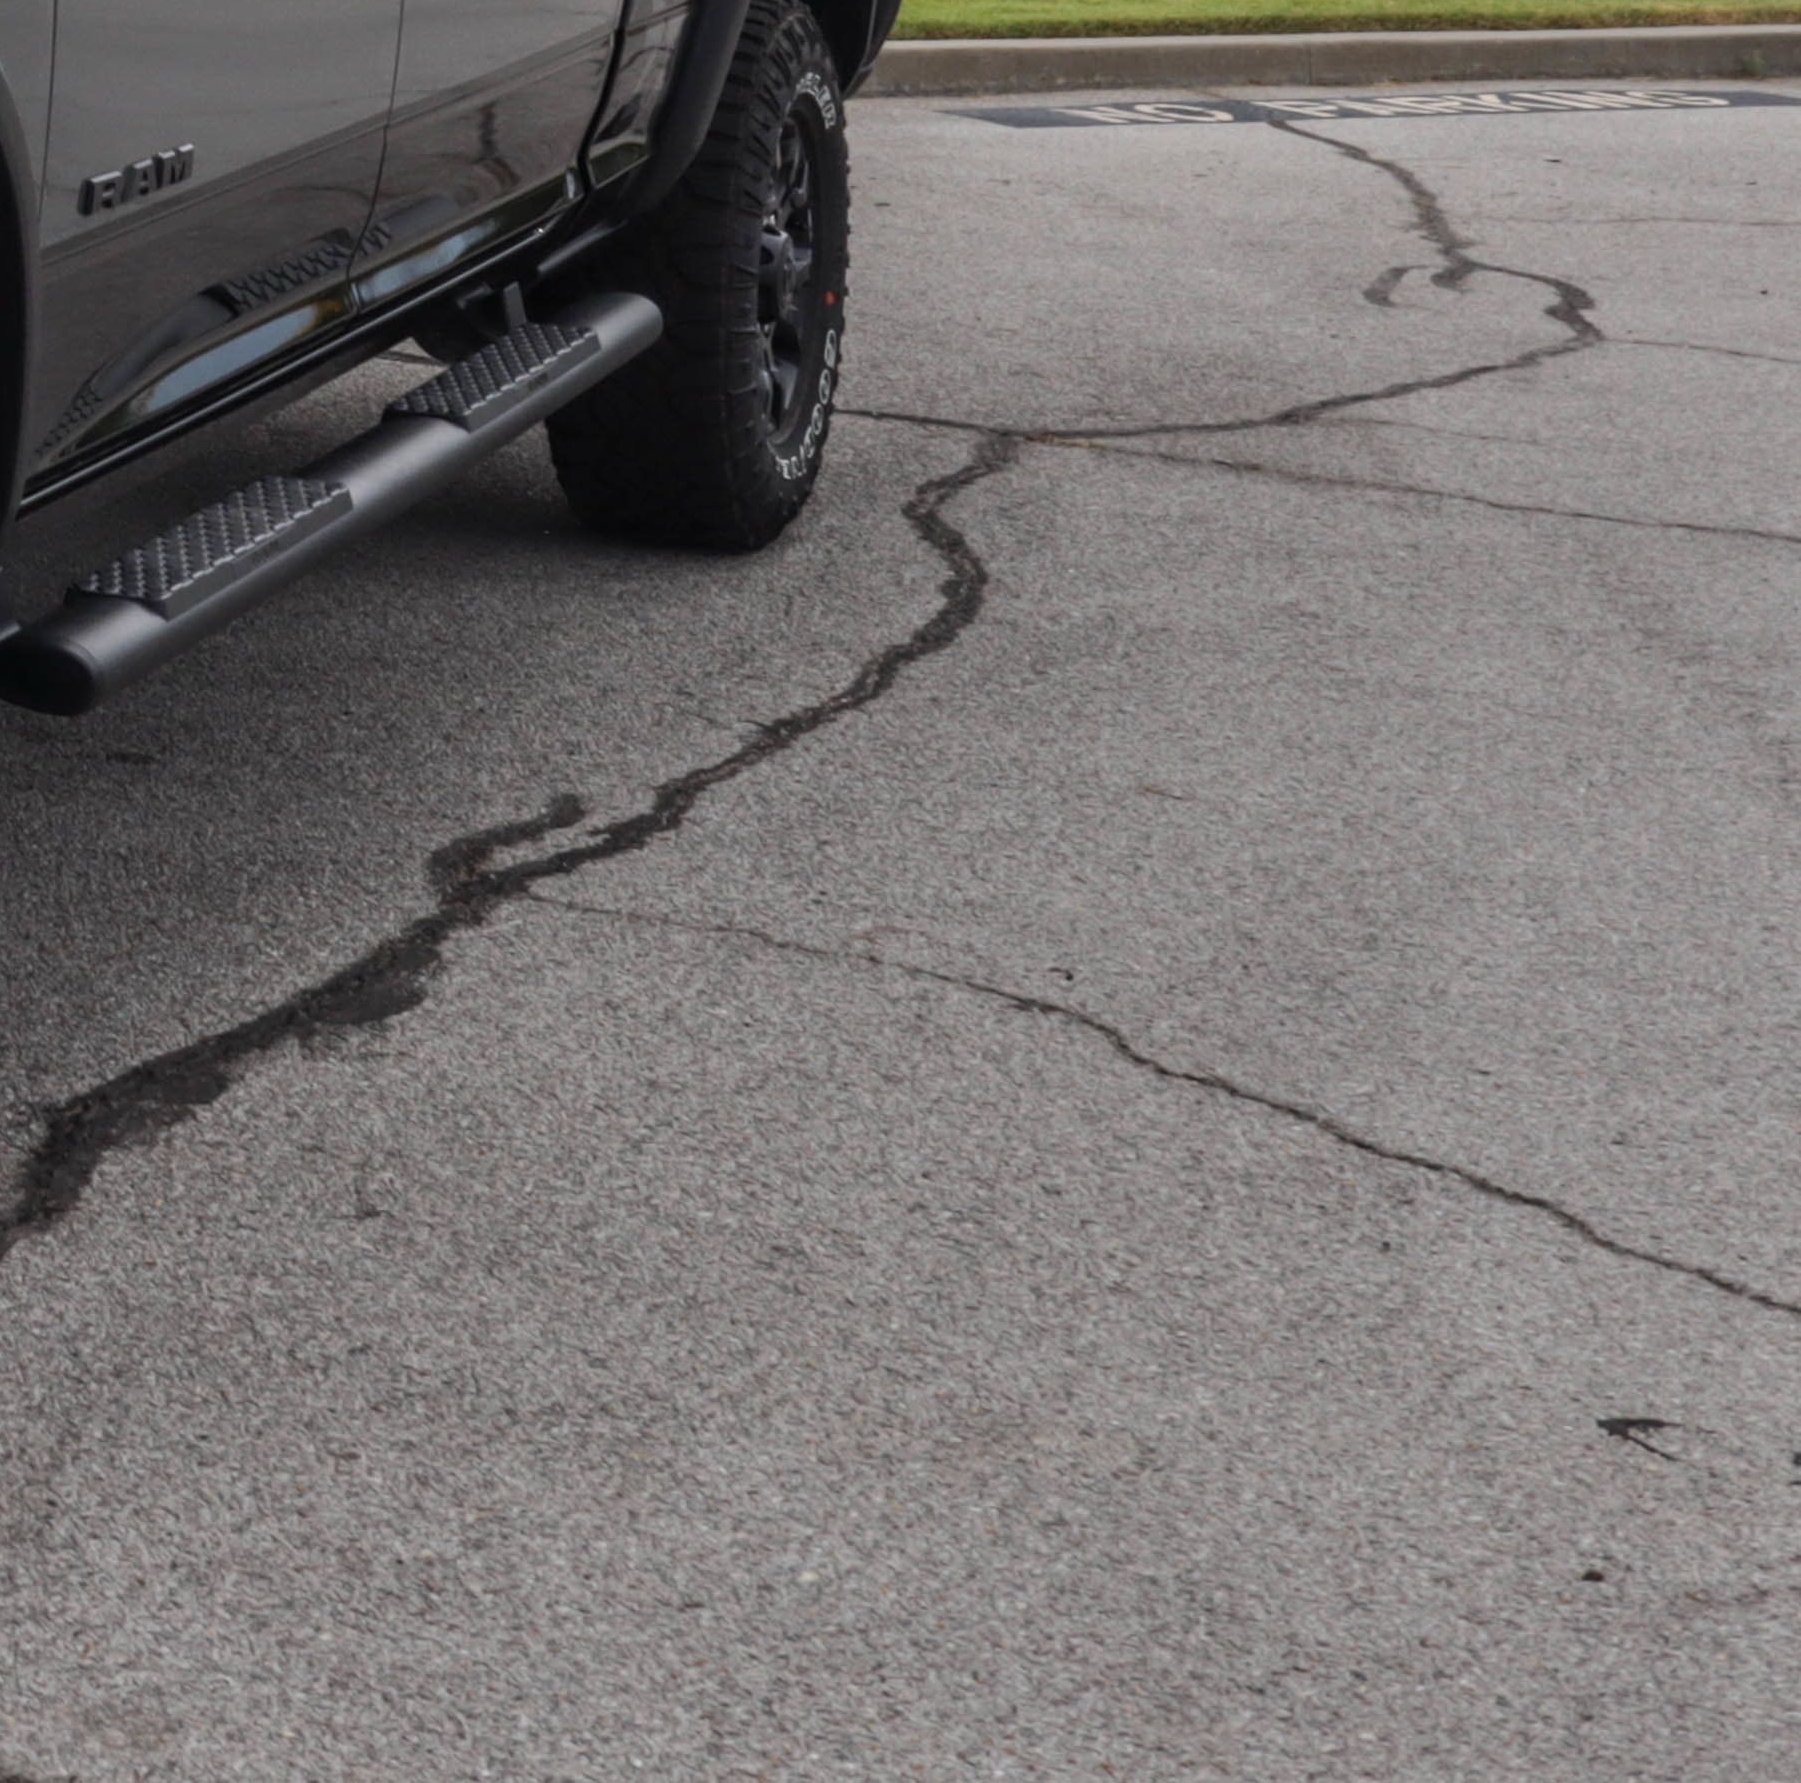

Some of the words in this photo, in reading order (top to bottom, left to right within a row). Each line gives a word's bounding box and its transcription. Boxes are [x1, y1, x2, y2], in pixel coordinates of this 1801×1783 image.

[1052, 103, 1235, 124] NO
[1251, 91, 1730, 118] PARKING
[78, 143, 195, 216] RAM
